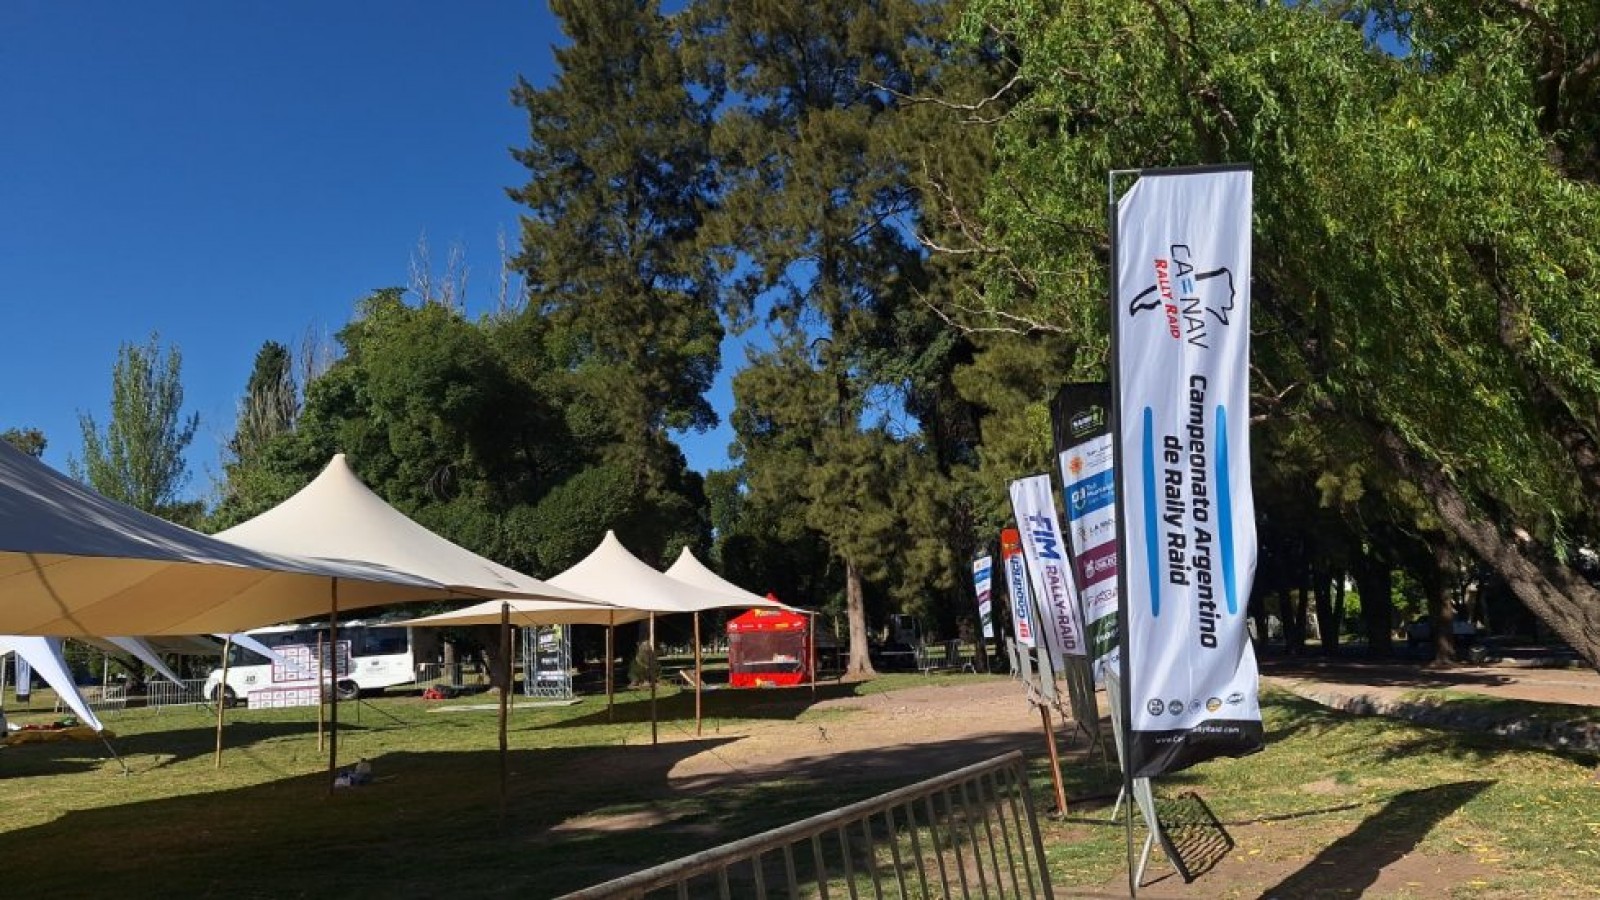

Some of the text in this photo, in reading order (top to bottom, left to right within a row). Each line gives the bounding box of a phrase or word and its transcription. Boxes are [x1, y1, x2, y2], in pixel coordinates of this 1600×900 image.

[1154, 258, 1181, 340] RALLY RAID
[1029, 510, 1062, 561] FIM
[1163, 435, 1191, 586] de Rally Raid
[1186, 374, 1222, 649] Campeonato Argentino
[1045, 564, 1076, 650] RALLY-RAID
